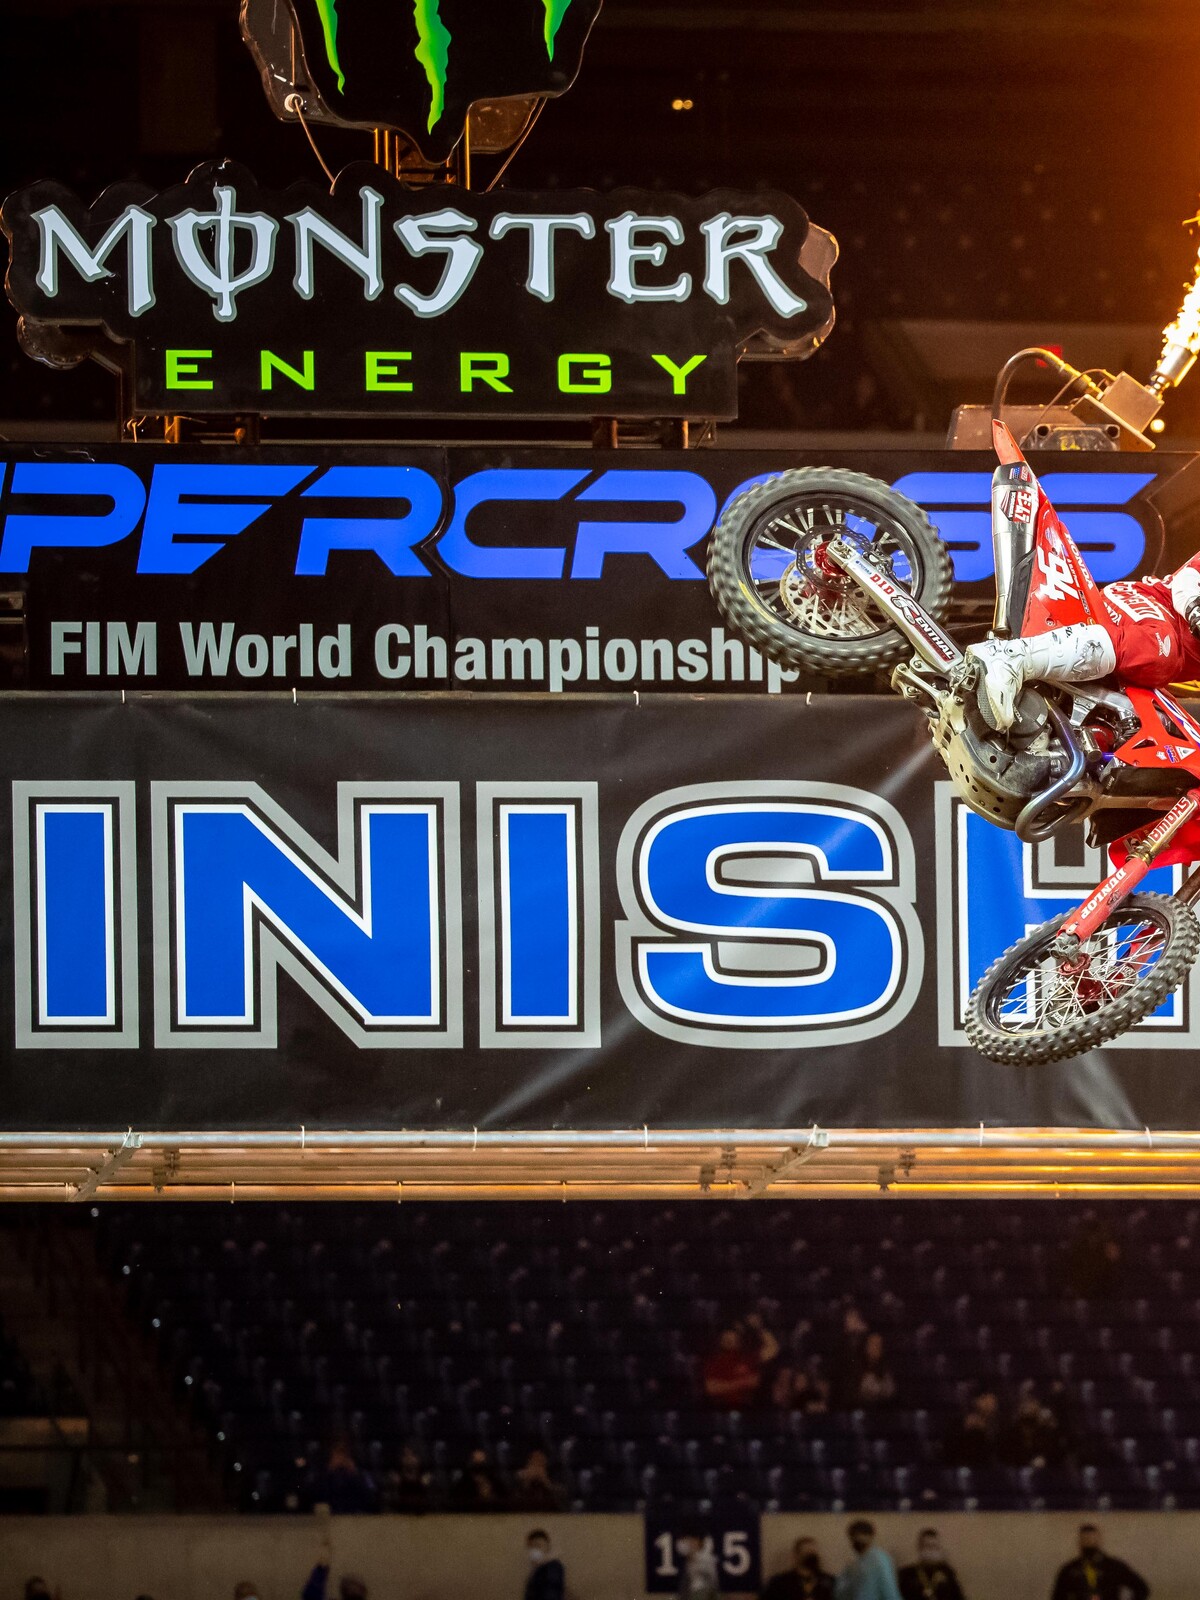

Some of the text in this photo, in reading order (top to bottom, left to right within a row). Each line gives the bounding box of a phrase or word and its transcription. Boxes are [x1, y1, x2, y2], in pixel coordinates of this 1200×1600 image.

[31, 184, 807, 322] MONSTER
[165, 349, 708, 395] ENERGY
[1037, 545, 1080, 600] 94
[1065, 532, 1093, 590] HONDA
[51, 622, 801, 694] FIM World Championship
[1149, 796, 1191, 843] SHOWA
[1081, 867, 1127, 920] DUNLOP
[654, 1530, 751, 1577] 15
